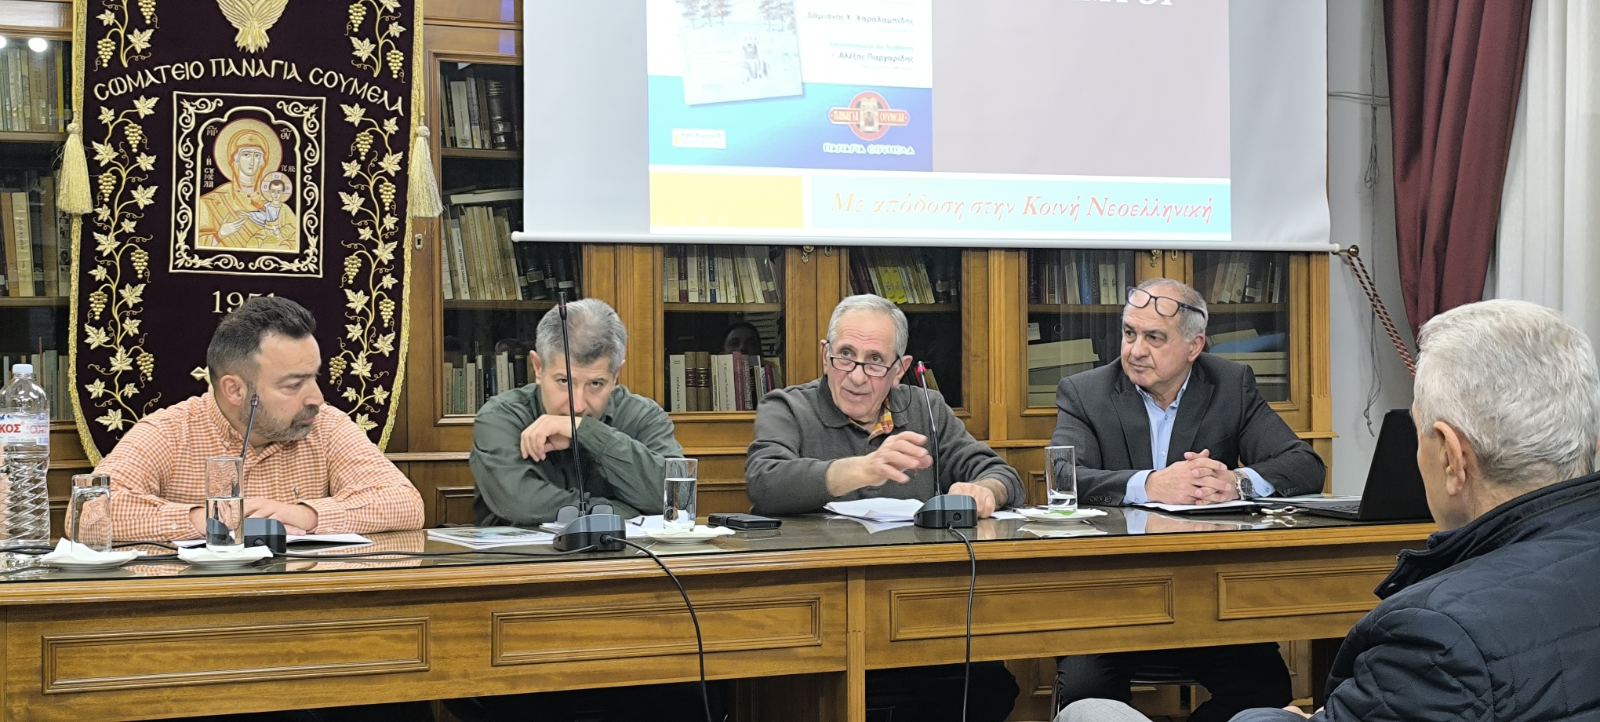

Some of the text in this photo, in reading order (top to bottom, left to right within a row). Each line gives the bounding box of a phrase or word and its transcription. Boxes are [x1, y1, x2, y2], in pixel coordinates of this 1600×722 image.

[211, 58, 303, 83] ΠΑΝΑΓΙΑ
[1023, 195, 1081, 223] Κοινή
[1087, 196, 1213, 224] Νεοελληνική
